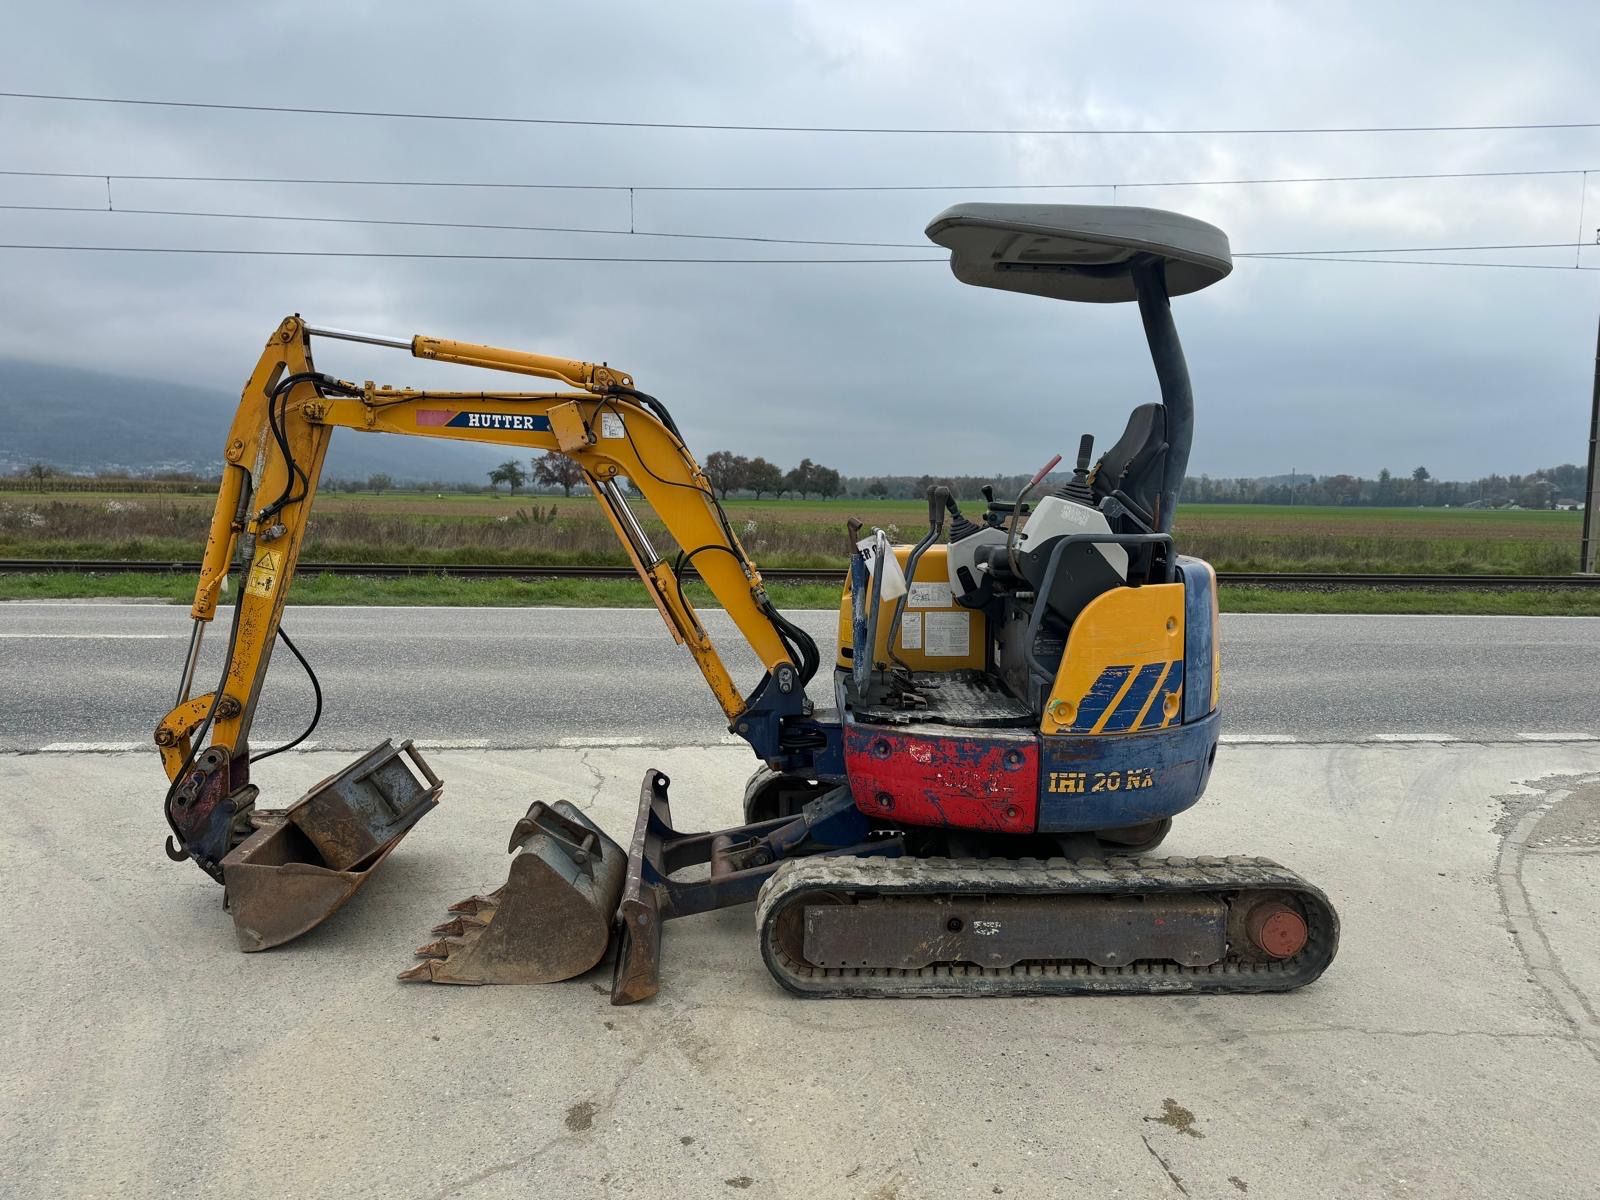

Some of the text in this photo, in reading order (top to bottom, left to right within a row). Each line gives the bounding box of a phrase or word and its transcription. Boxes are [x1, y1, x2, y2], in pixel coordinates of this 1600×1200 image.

[468, 413, 533, 430] HUTTER
[1048, 772, 1086, 793] IHI
[1091, 771, 1121, 793] 20
